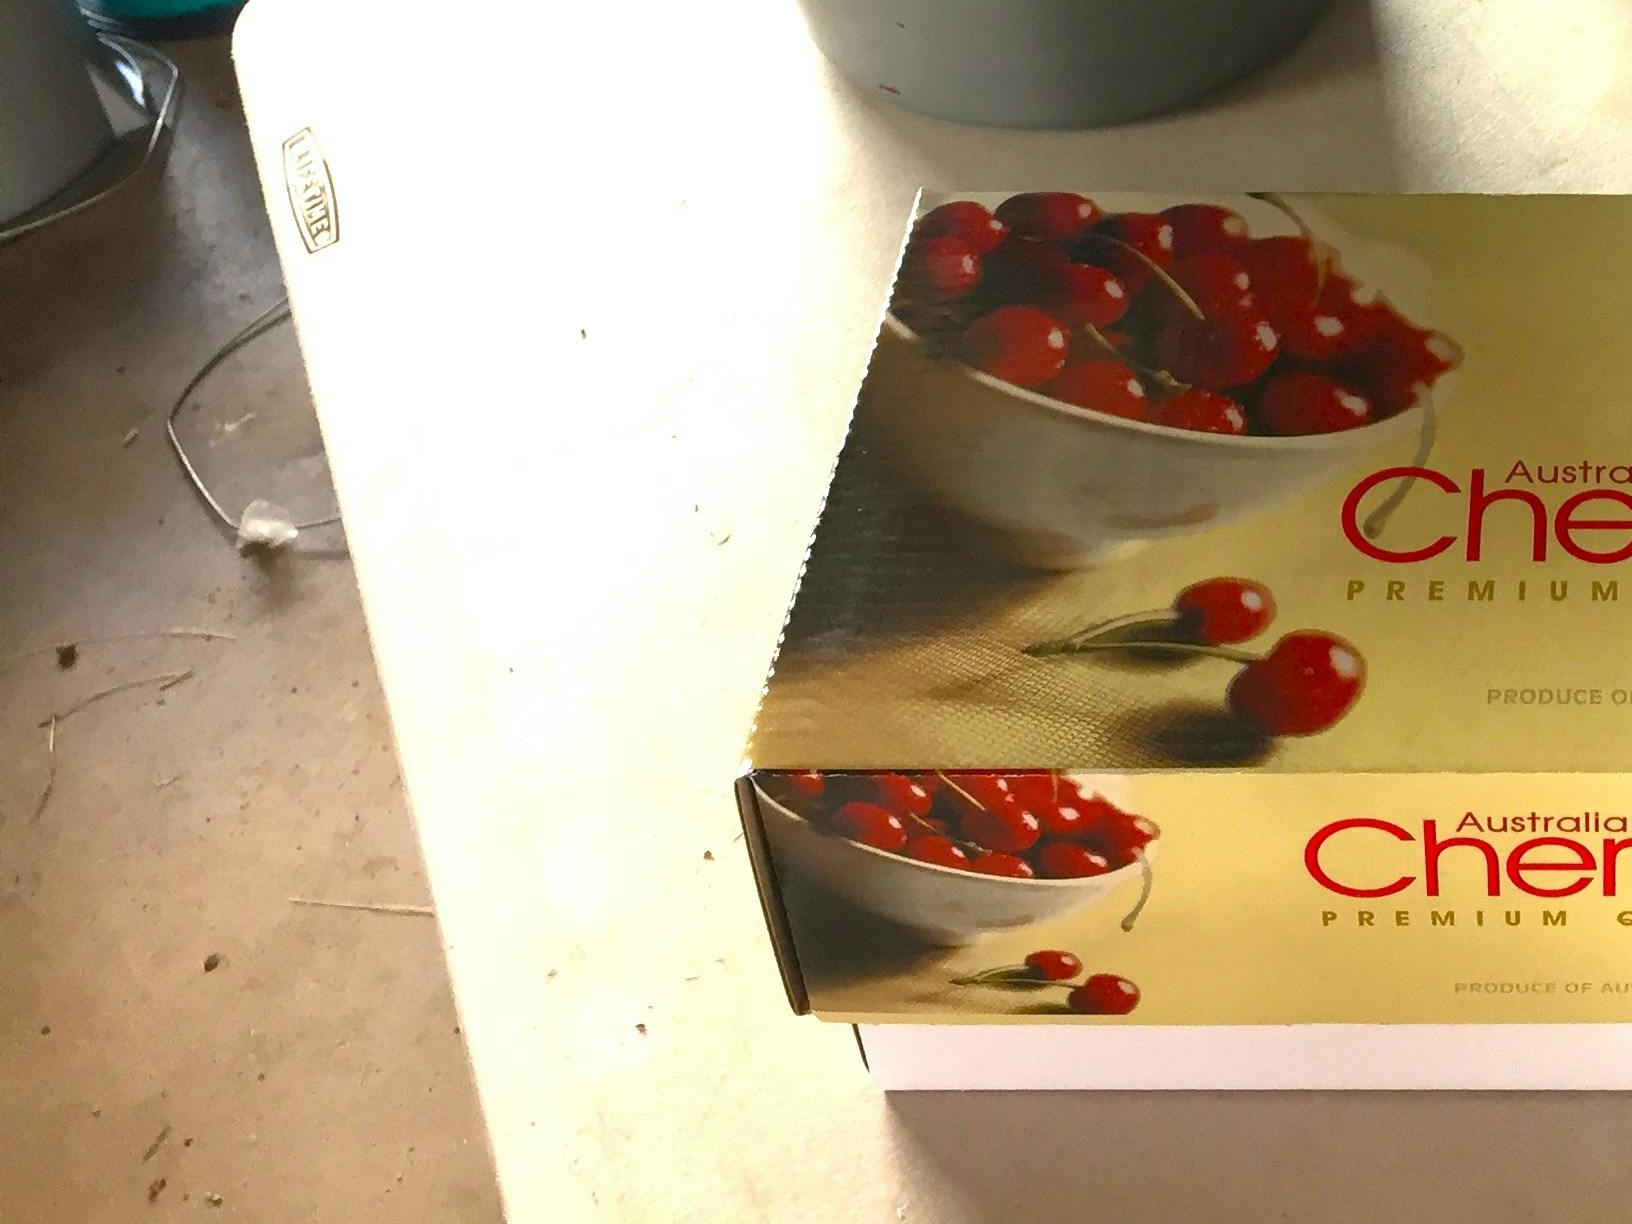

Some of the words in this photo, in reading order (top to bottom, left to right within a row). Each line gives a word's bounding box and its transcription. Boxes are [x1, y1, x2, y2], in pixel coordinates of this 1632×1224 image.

[1346, 580, 1618, 602] PREMIUM
[1486, 688, 1602, 706] PRODUCE
[1321, 910, 1568, 927] PREMIUM
[1454, 982, 1557, 995] PRODUCE
[1564, 982, 1593, 995] OF
